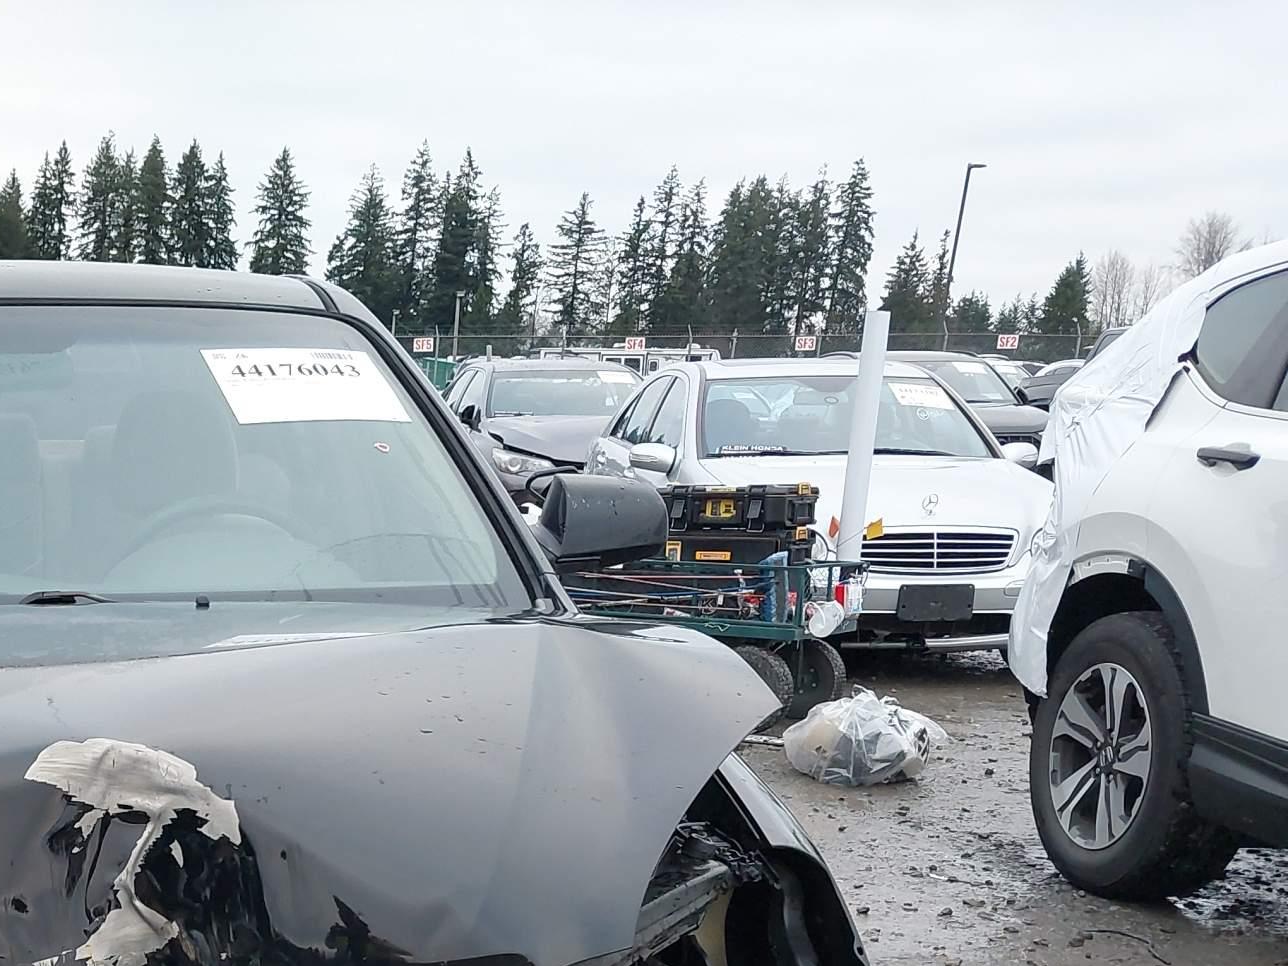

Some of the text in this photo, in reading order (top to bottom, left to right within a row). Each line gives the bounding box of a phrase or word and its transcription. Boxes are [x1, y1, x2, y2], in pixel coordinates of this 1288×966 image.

[415, 339, 432, 350] SF5
[627, 338, 643, 350] SF4
[797, 337, 815, 349] SF3
[999, 336, 1017, 347] SF2
[230, 363, 361, 377] 44176043
